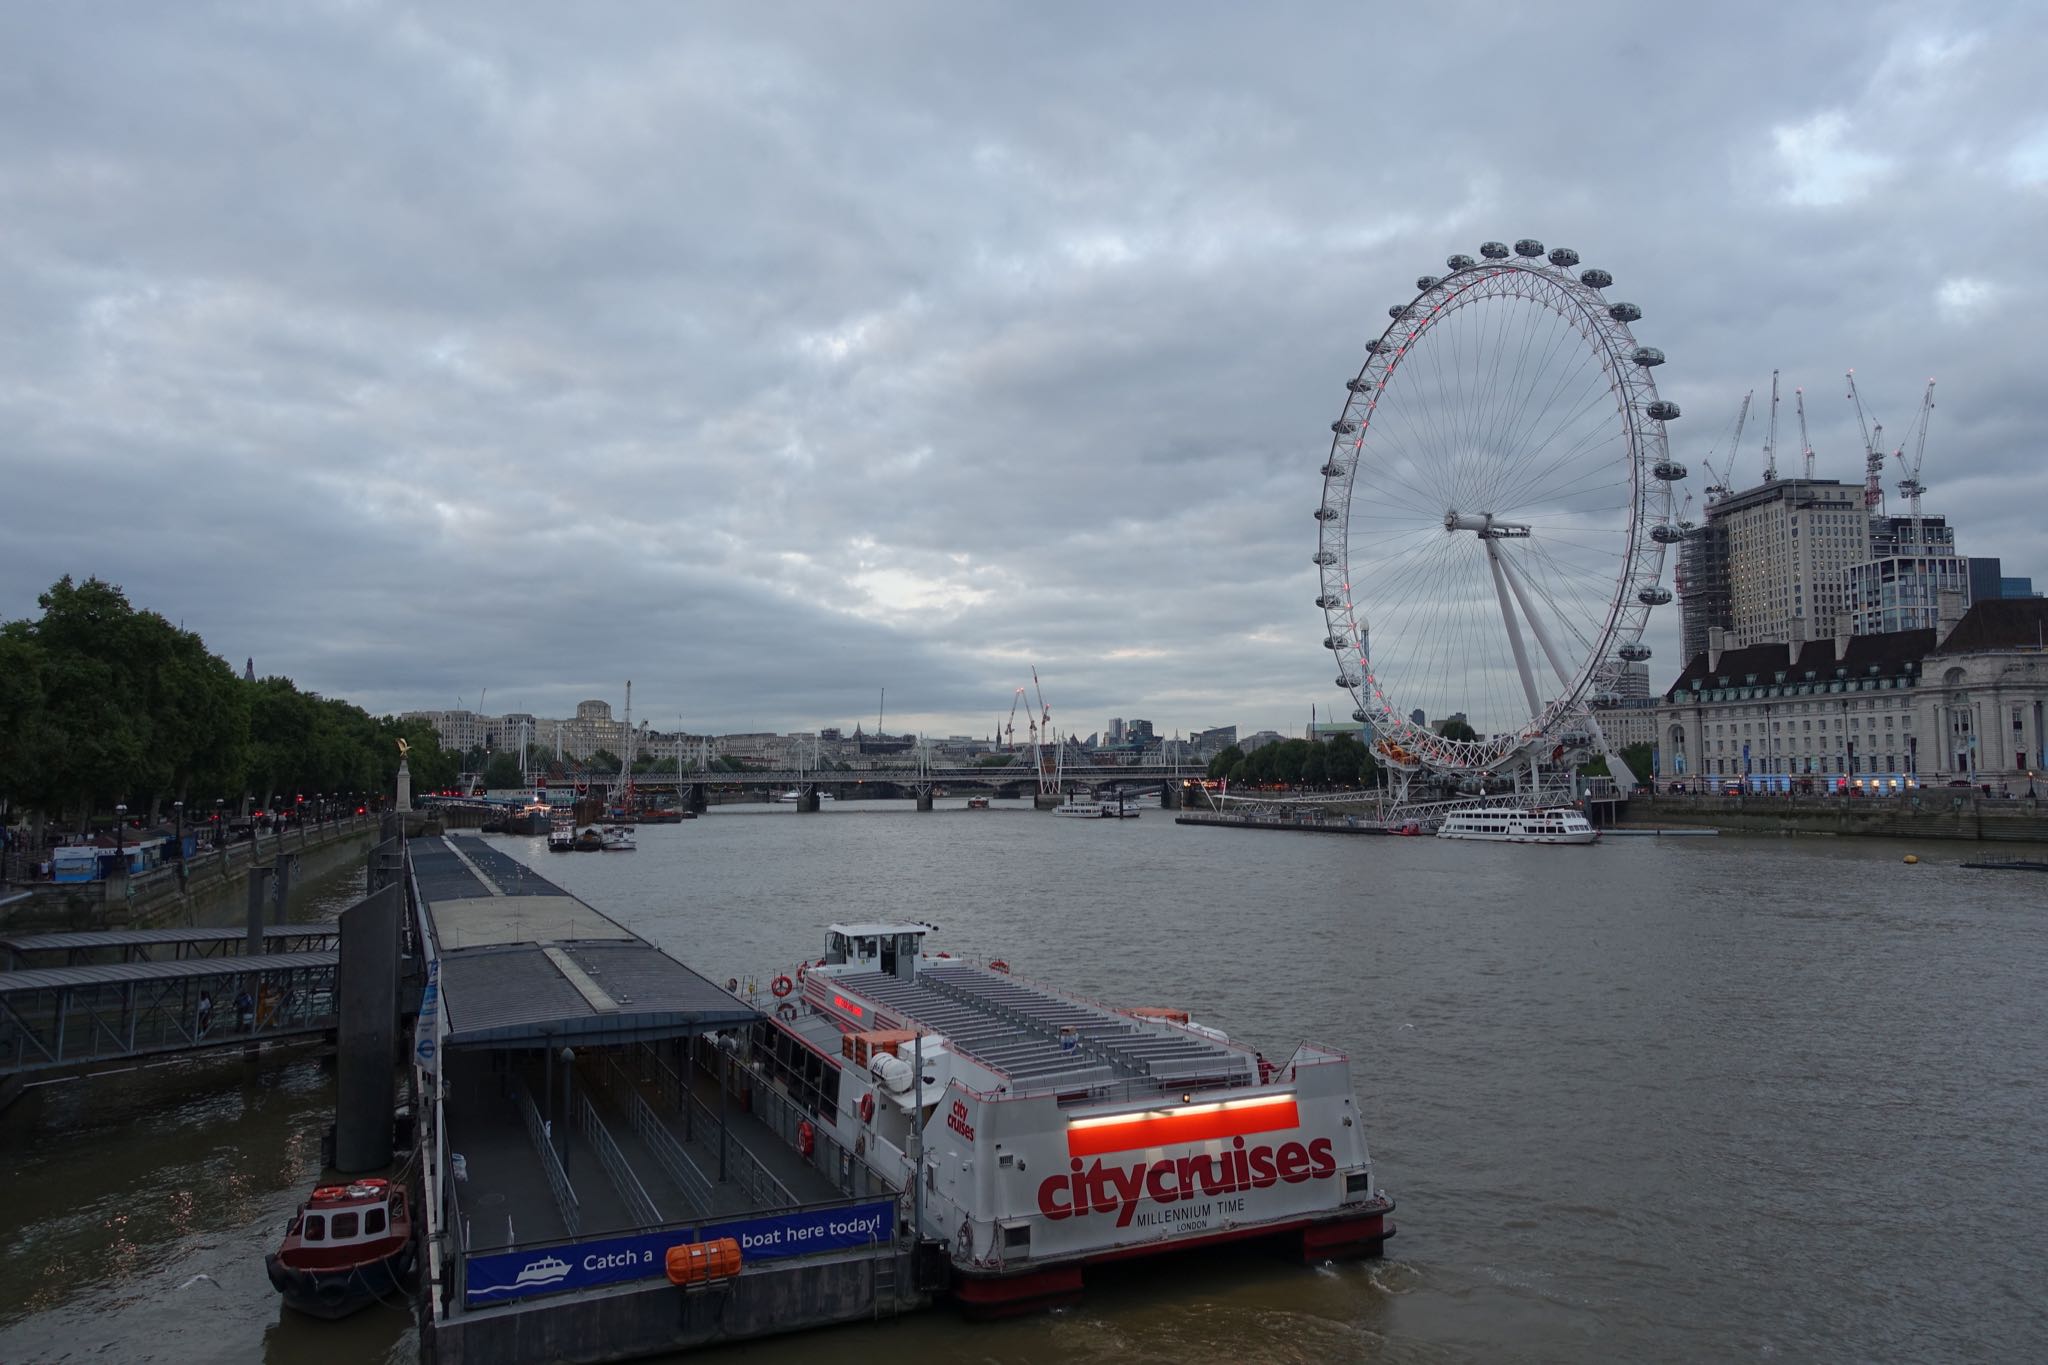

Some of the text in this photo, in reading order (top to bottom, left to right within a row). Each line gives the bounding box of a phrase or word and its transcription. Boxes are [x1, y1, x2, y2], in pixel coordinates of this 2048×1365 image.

[953, 1099, 968, 1121] city
[947, 1113, 975, 1142] cruises
[1038, 1135, 1337, 1228] citycruises
[1137, 1198, 1245, 1228] MILLENNIUM TIME
[1176, 1220, 1208, 1232] LONDON
[583, 1214, 881, 1272] Catch a boat here today!
